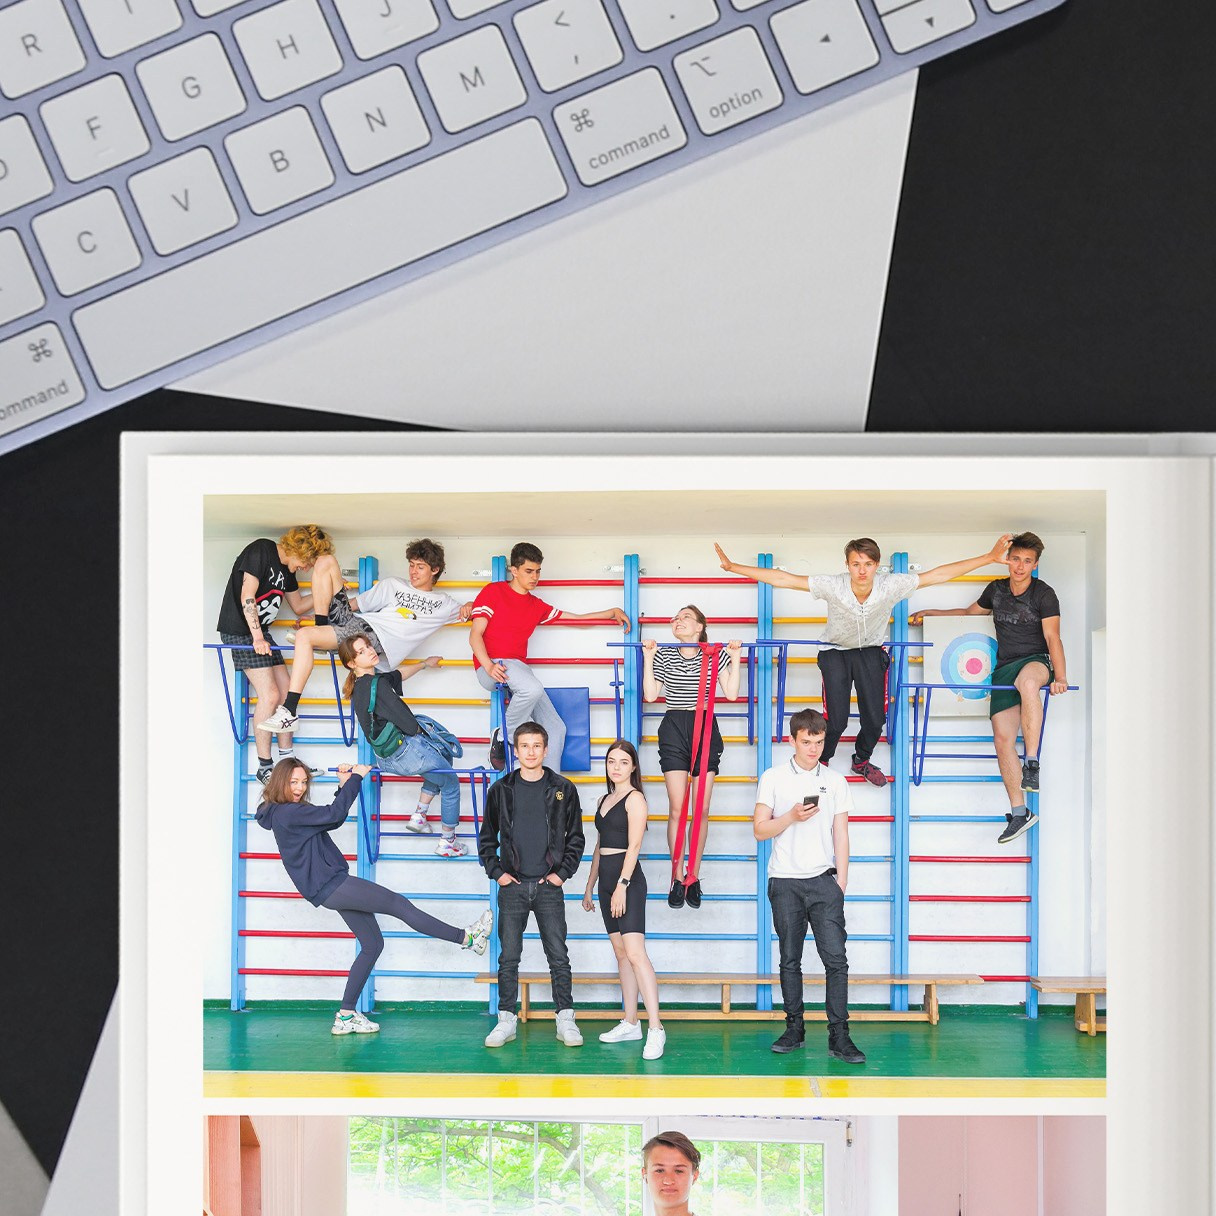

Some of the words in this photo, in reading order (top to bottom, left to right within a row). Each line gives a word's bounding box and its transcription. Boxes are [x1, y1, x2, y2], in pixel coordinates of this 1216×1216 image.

[21, 33, 42, 56] R
[276, 34, 300, 59] H
[181, 76, 201, 99] G
[459, 65, 486, 93] M
[708, 87, 764, 119] option
[86, 116, 101, 140] F
[364, 107, 388, 132] N
[588, 124, 671, 169] command
[269, 149, 290, 173] B
[171, 188, 189, 212] V
[77, 230, 97, 254] C
[0, 379, 69, 421] ommand
